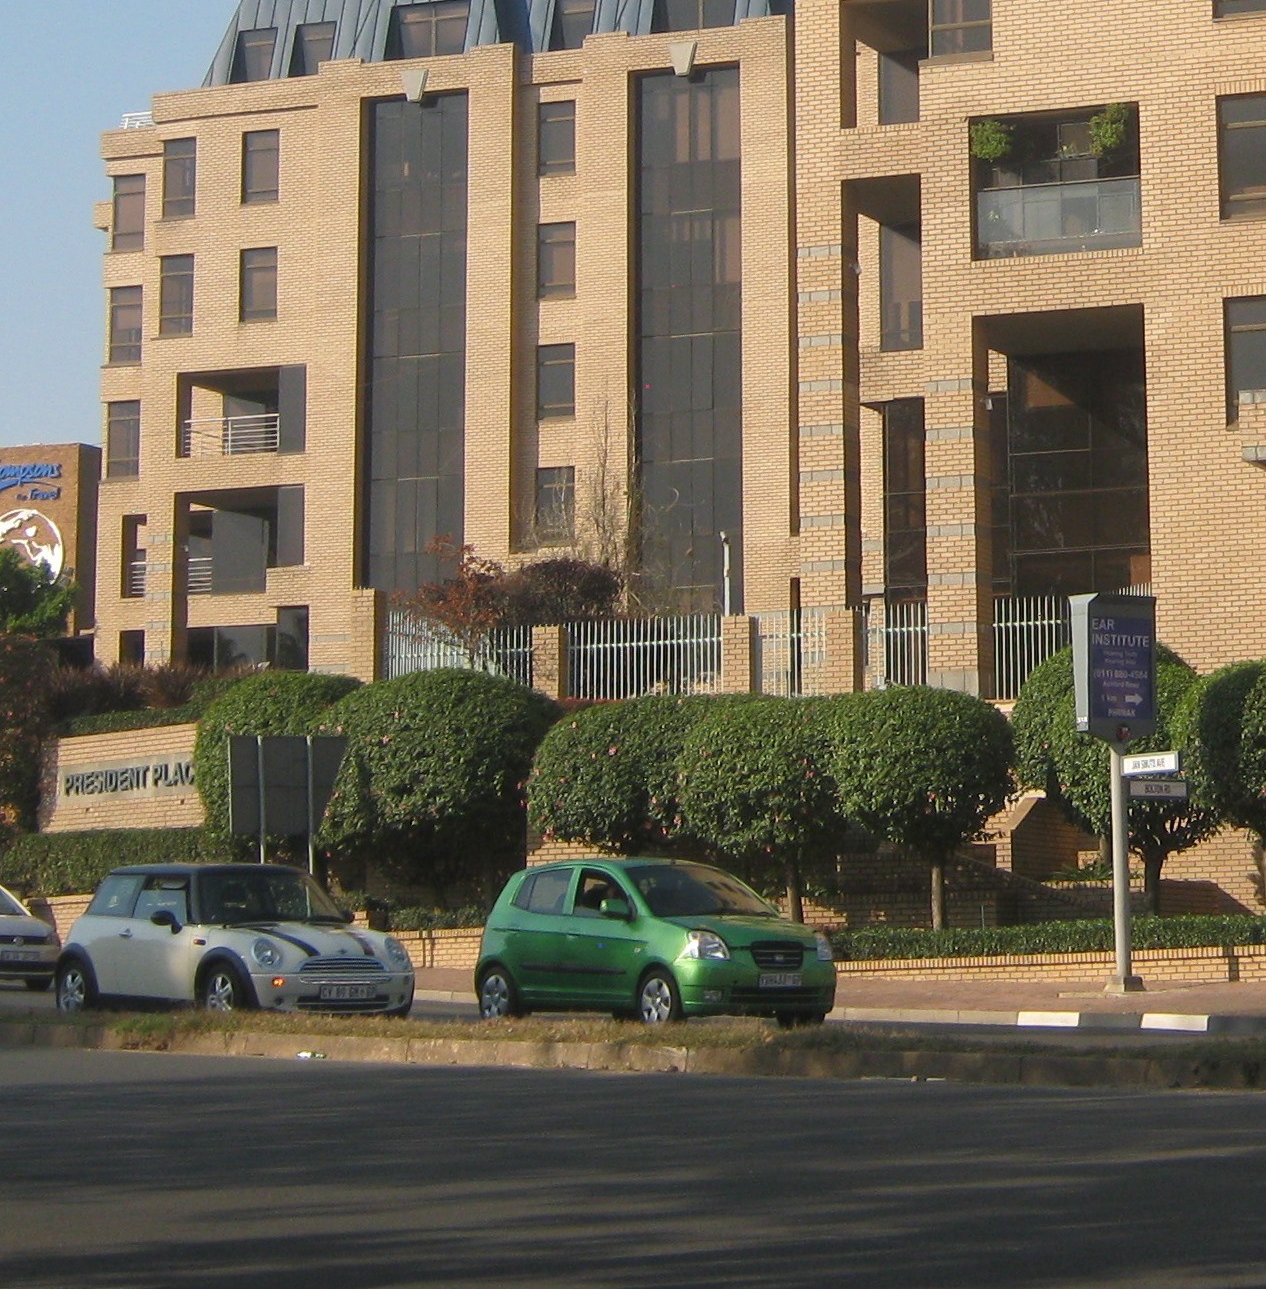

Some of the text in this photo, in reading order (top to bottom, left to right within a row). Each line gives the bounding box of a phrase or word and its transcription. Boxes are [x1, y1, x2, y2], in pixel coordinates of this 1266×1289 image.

[1091, 618, 1115, 631] EAR
[1091, 633, 1150, 648] INSTITUTE
[64, 761, 196, 796] PRESIDENT PLAC
